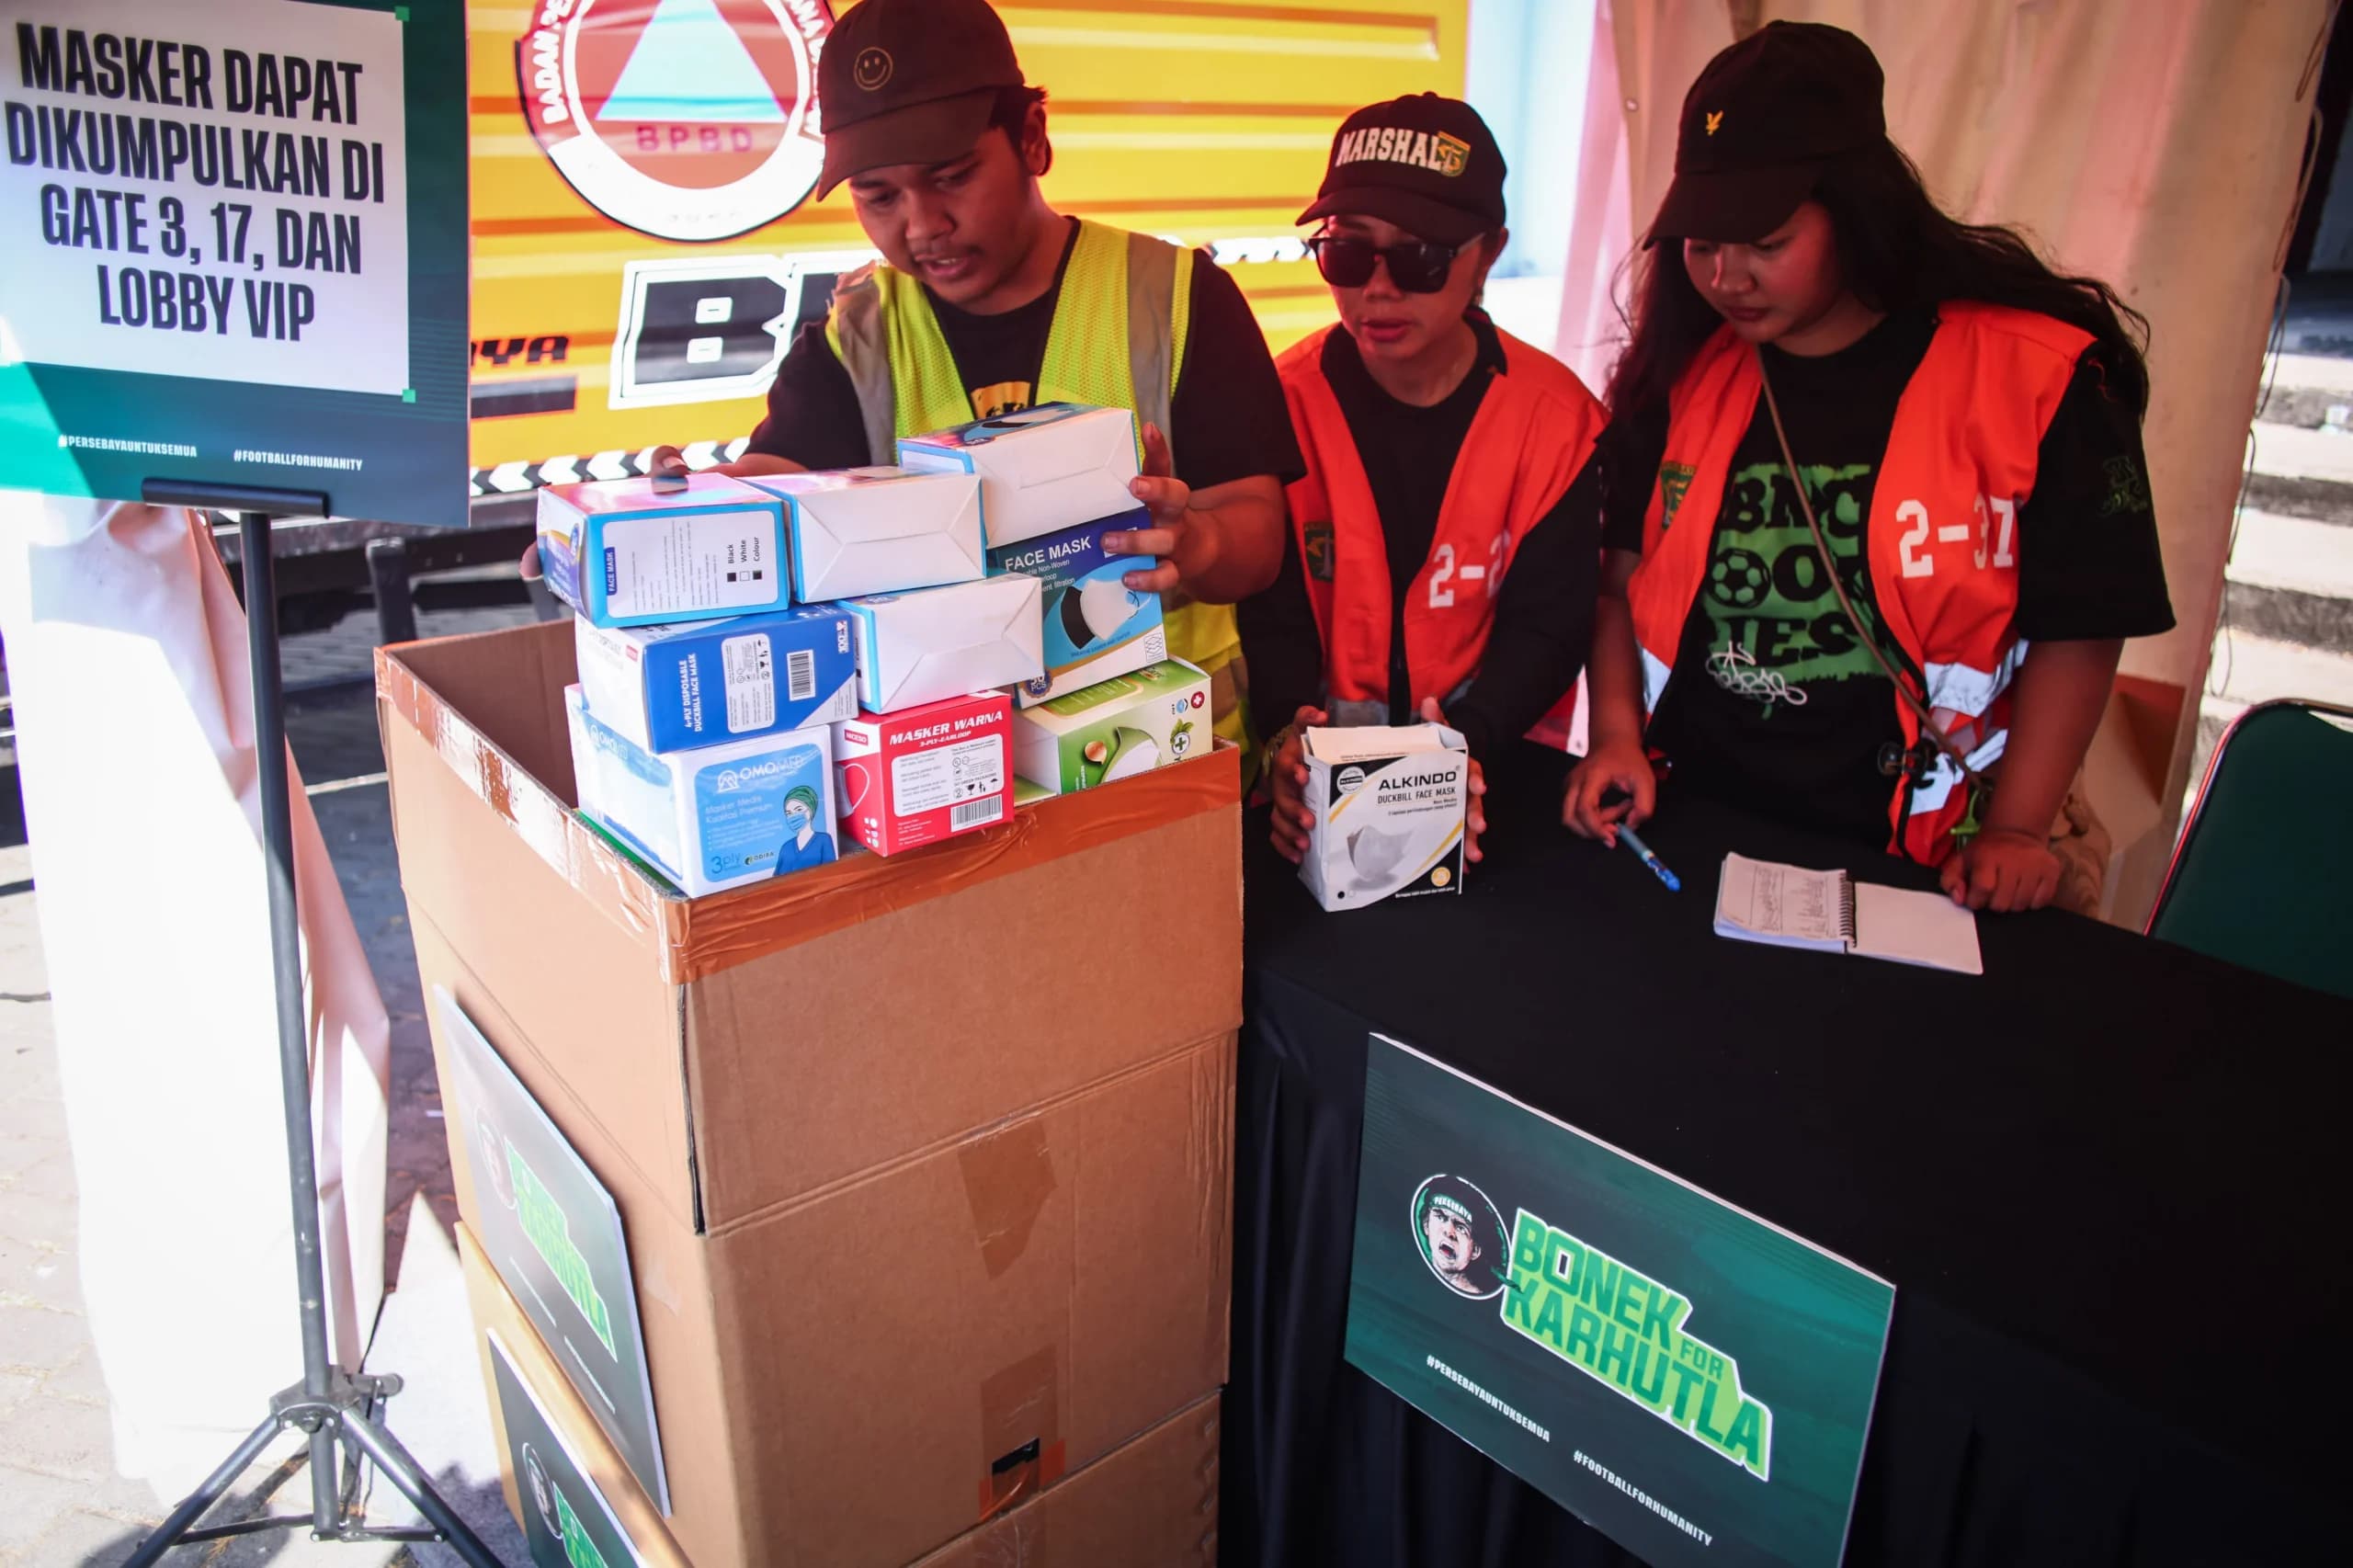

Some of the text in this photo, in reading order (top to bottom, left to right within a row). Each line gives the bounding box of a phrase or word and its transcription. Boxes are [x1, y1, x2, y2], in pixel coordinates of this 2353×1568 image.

[16, 22, 363, 126] MASKER DAPAT
[532, 30, 569, 124] BADAN
[4, 100, 384, 203] DIKUMPULKAN DI
[636, 126, 753, 153] BPBD
[1335, 127, 1444, 172] MARSHAL
[40, 184, 361, 275] GATE 3, 17, DAN
[97, 264, 315, 342] LOBBY VIP
[233, 449, 364, 472] #FOOTBALLFORHUMANITY
[726, 543, 735, 564] Black
[739, 539, 748, 563] White
[752, 536, 761, 562] Colour
[1005, 536, 1092, 572] FACE MASK
[1038, 559, 1071, 573] Non-Woven
[607, 551, 617, 593] FACE MASK
[678, 660, 691, 707] DISPOSABLE
[688, 653, 703, 733] DUCKBILL FACE MASK
[889, 710, 1004, 746] MASKER WARNA
[1377, 786, 1456, 804] DUCKBILL FACE MASK
[1378, 771, 1457, 791] ALKINDO
[1434, 1196, 1472, 1223] PERSEBAYA
[1515, 1218, 1684, 1351] BONEK
[1505, 1278, 1761, 1465] KARHUTLA
[1678, 1340, 1724, 1381] FOR
[1427, 1353, 1551, 1442] #PERSEBAYAUNTUKSEMUA
[1574, 1449, 1712, 1546] #FOOTBALLFORHUMANITY
